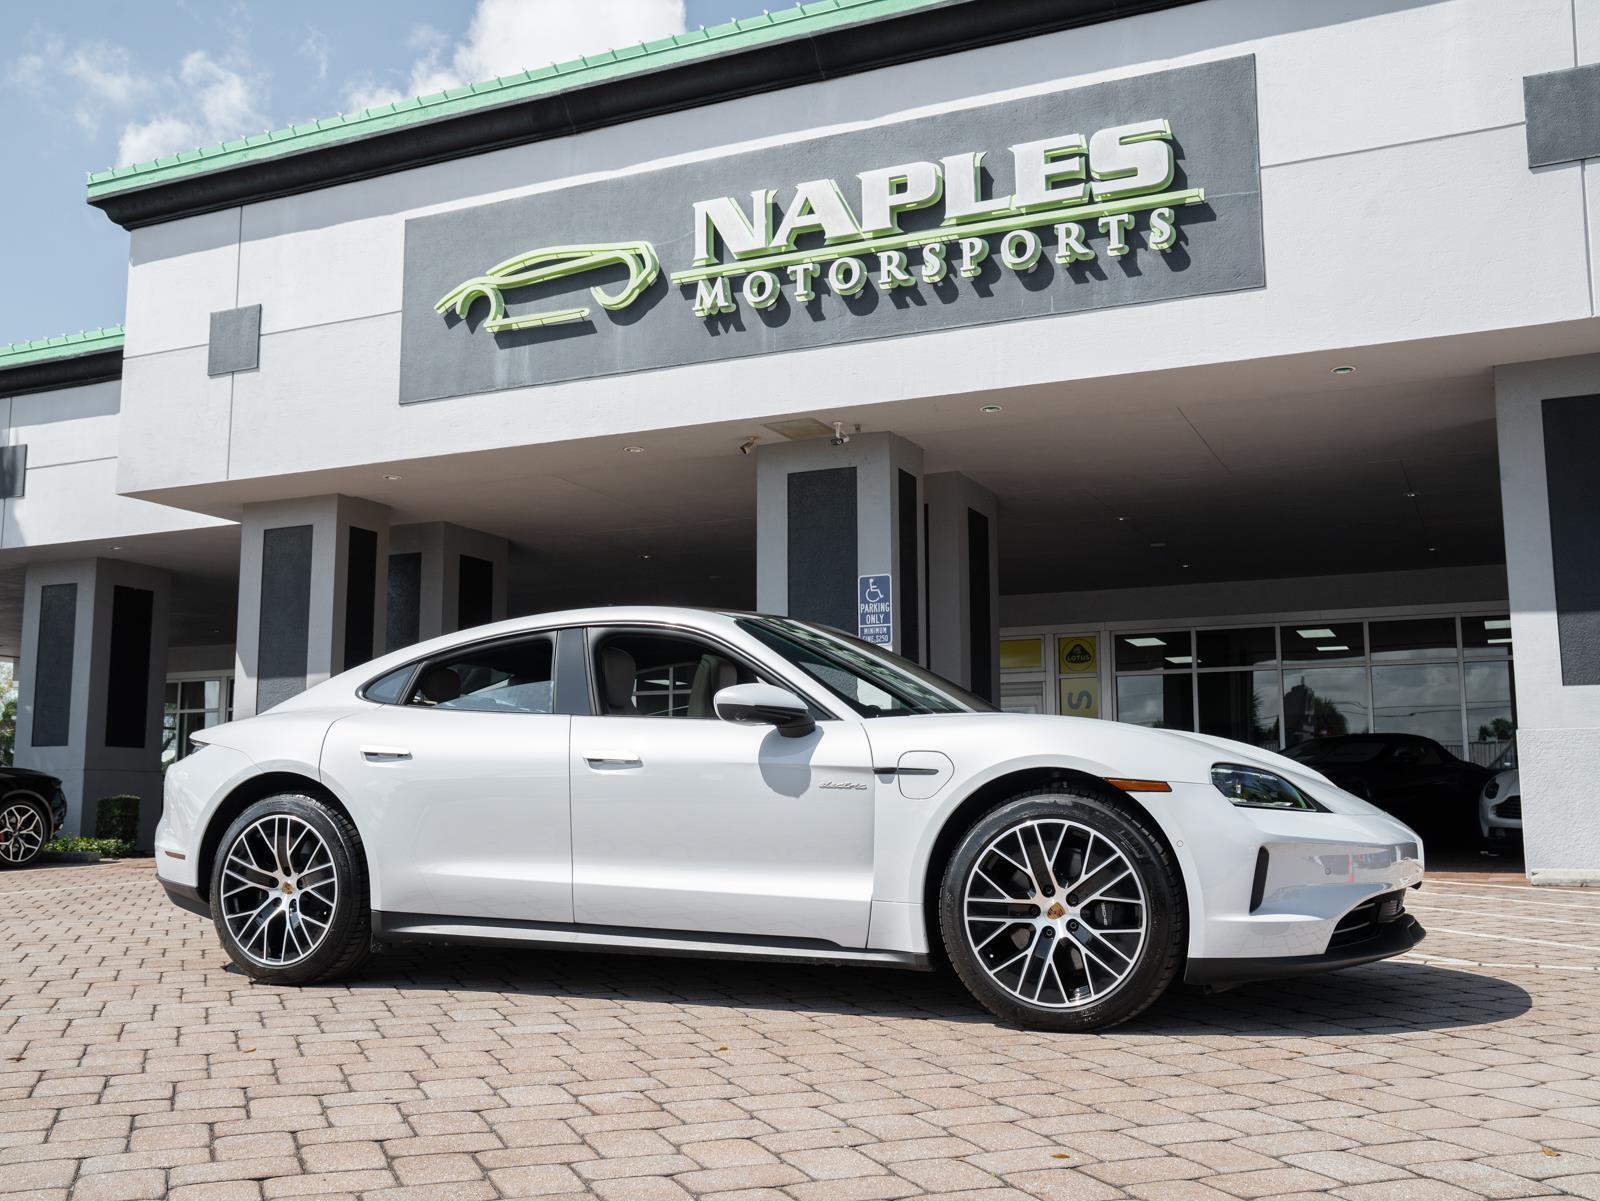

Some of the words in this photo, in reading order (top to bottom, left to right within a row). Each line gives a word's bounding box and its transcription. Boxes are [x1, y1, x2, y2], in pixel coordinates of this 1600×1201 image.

[691, 118, 1173, 268] NAPLES
[692, 207, 1176, 318] MOTORSPORTS
[861, 602, 890, 613] PARKING
[865, 614, 885, 624] ONLY
